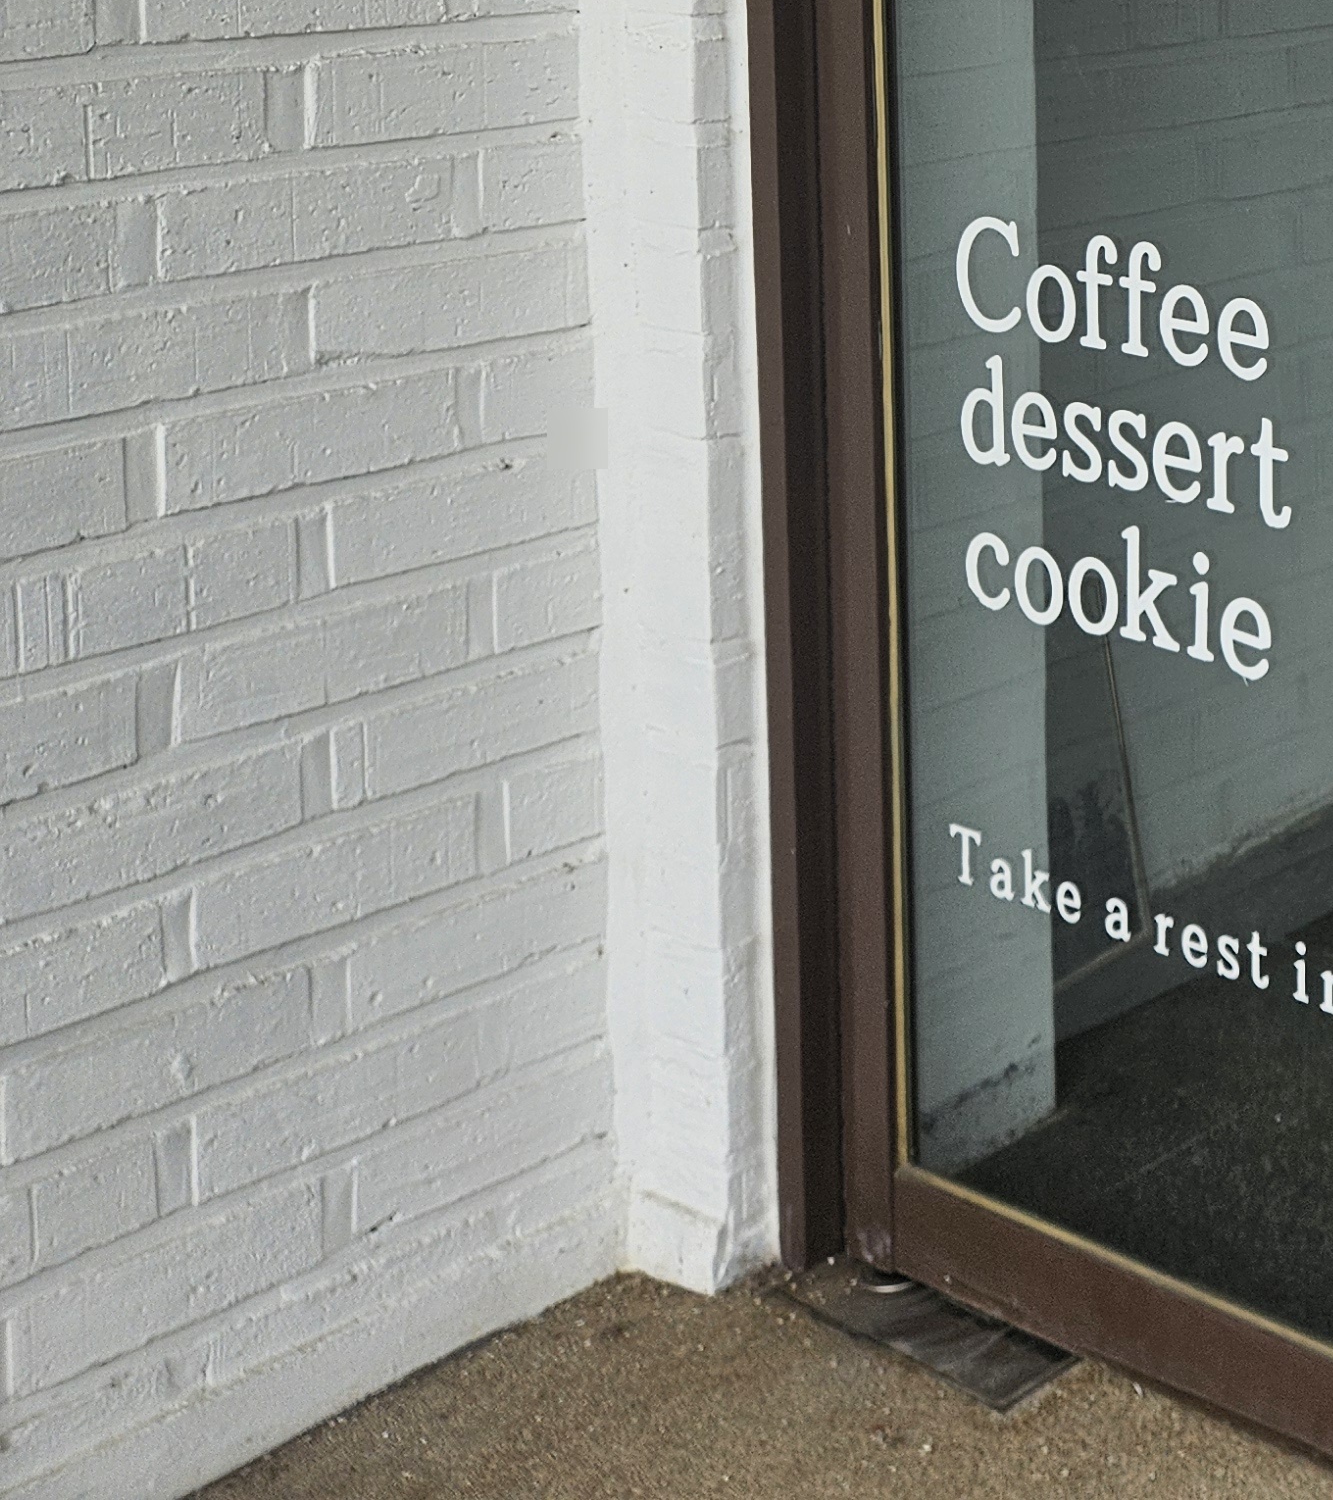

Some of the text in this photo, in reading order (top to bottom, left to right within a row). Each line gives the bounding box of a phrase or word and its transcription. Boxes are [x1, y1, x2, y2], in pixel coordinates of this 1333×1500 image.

[955, 216, 1270, 381] Coffee
[960, 355, 1292, 529] dessert
[965, 525, 1272, 681] cookie
[949, 823, 1082, 924] Take
[1104, 895, 1132, 943] a
[1152, 911, 1270, 990] rest
